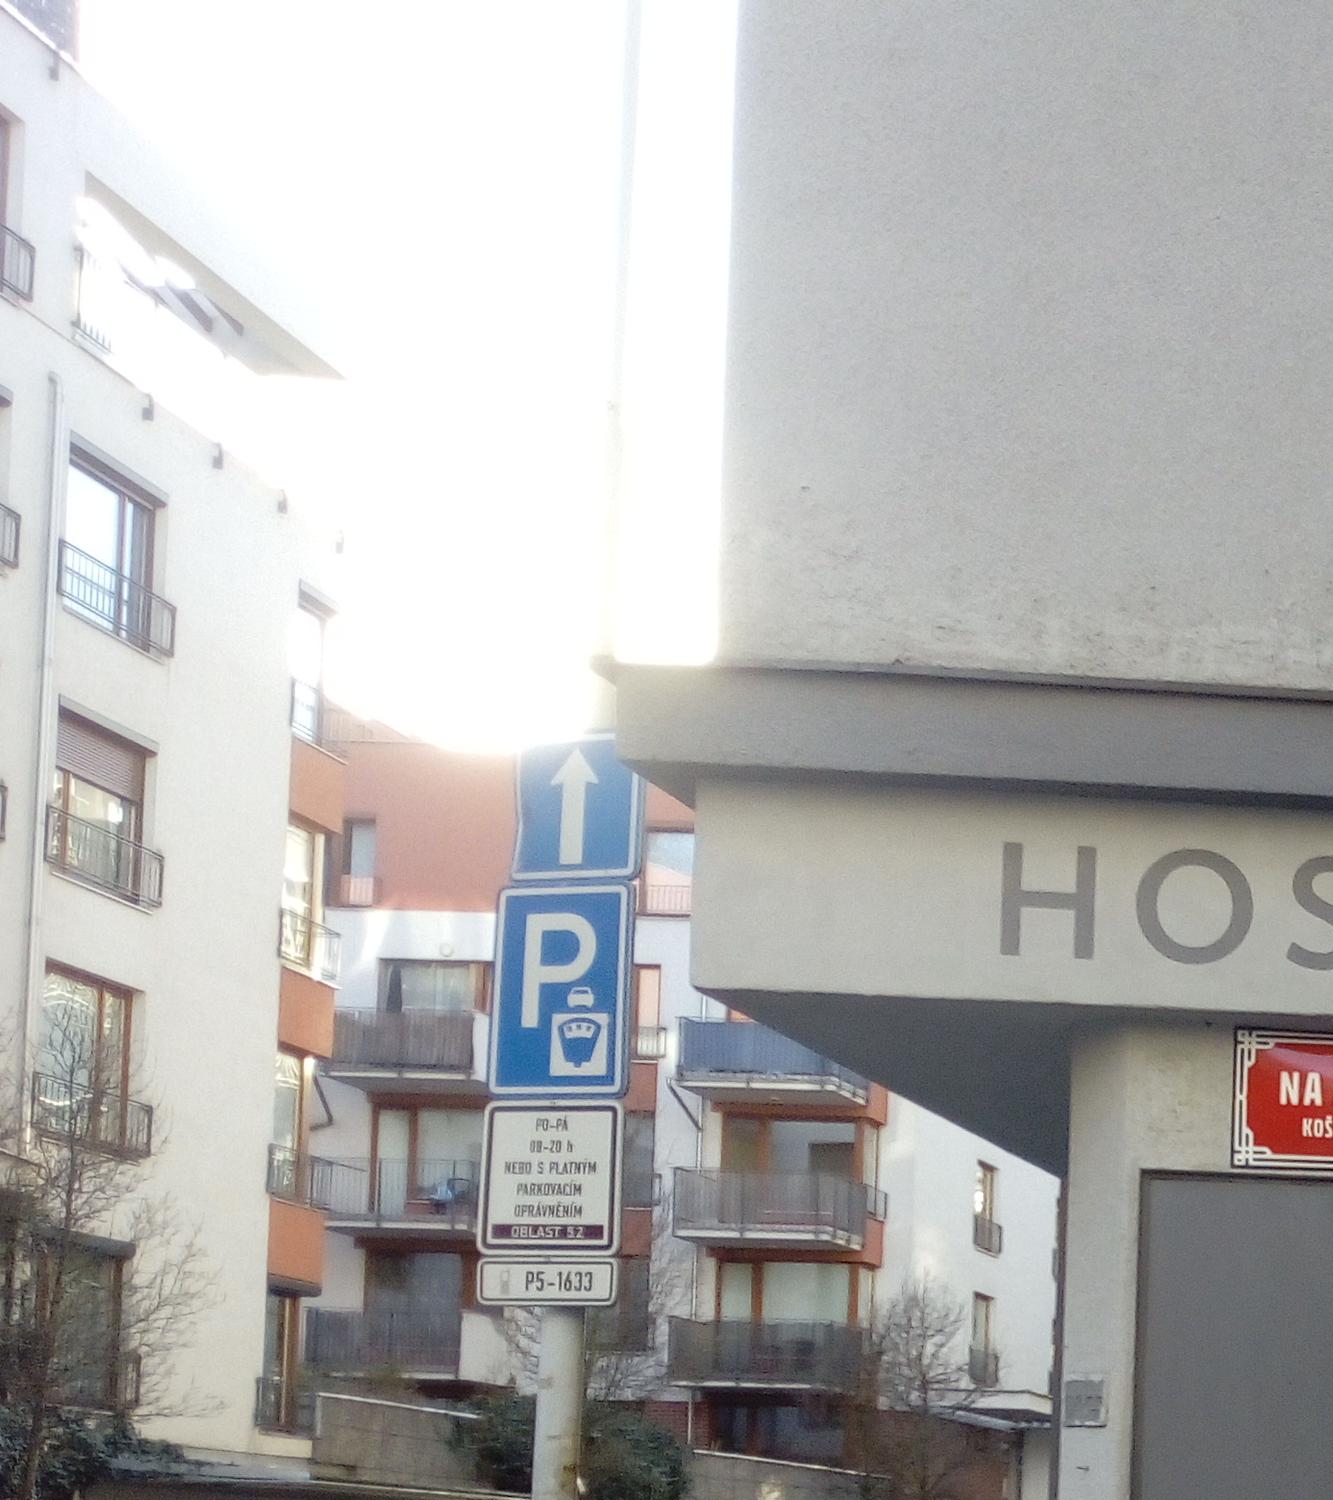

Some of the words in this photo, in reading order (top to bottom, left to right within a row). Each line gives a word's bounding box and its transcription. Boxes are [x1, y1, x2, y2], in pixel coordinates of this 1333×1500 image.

[521, 913, 598, 1029] P
[1278, 1070, 1323, 1107] NA
[535, 1116, 569, 1132] PO-PÁ
[504, 1161, 532, 1175] NEBO
[537, 1161, 544, 1175] S
[549, 1158, 597, 1175] PLATNÝM
[516, 1180, 583, 1197] PARKOVACÍM
[511, 1225, 562, 1238] OBLAST
[525, 1270, 593, 1292] P5-1633
